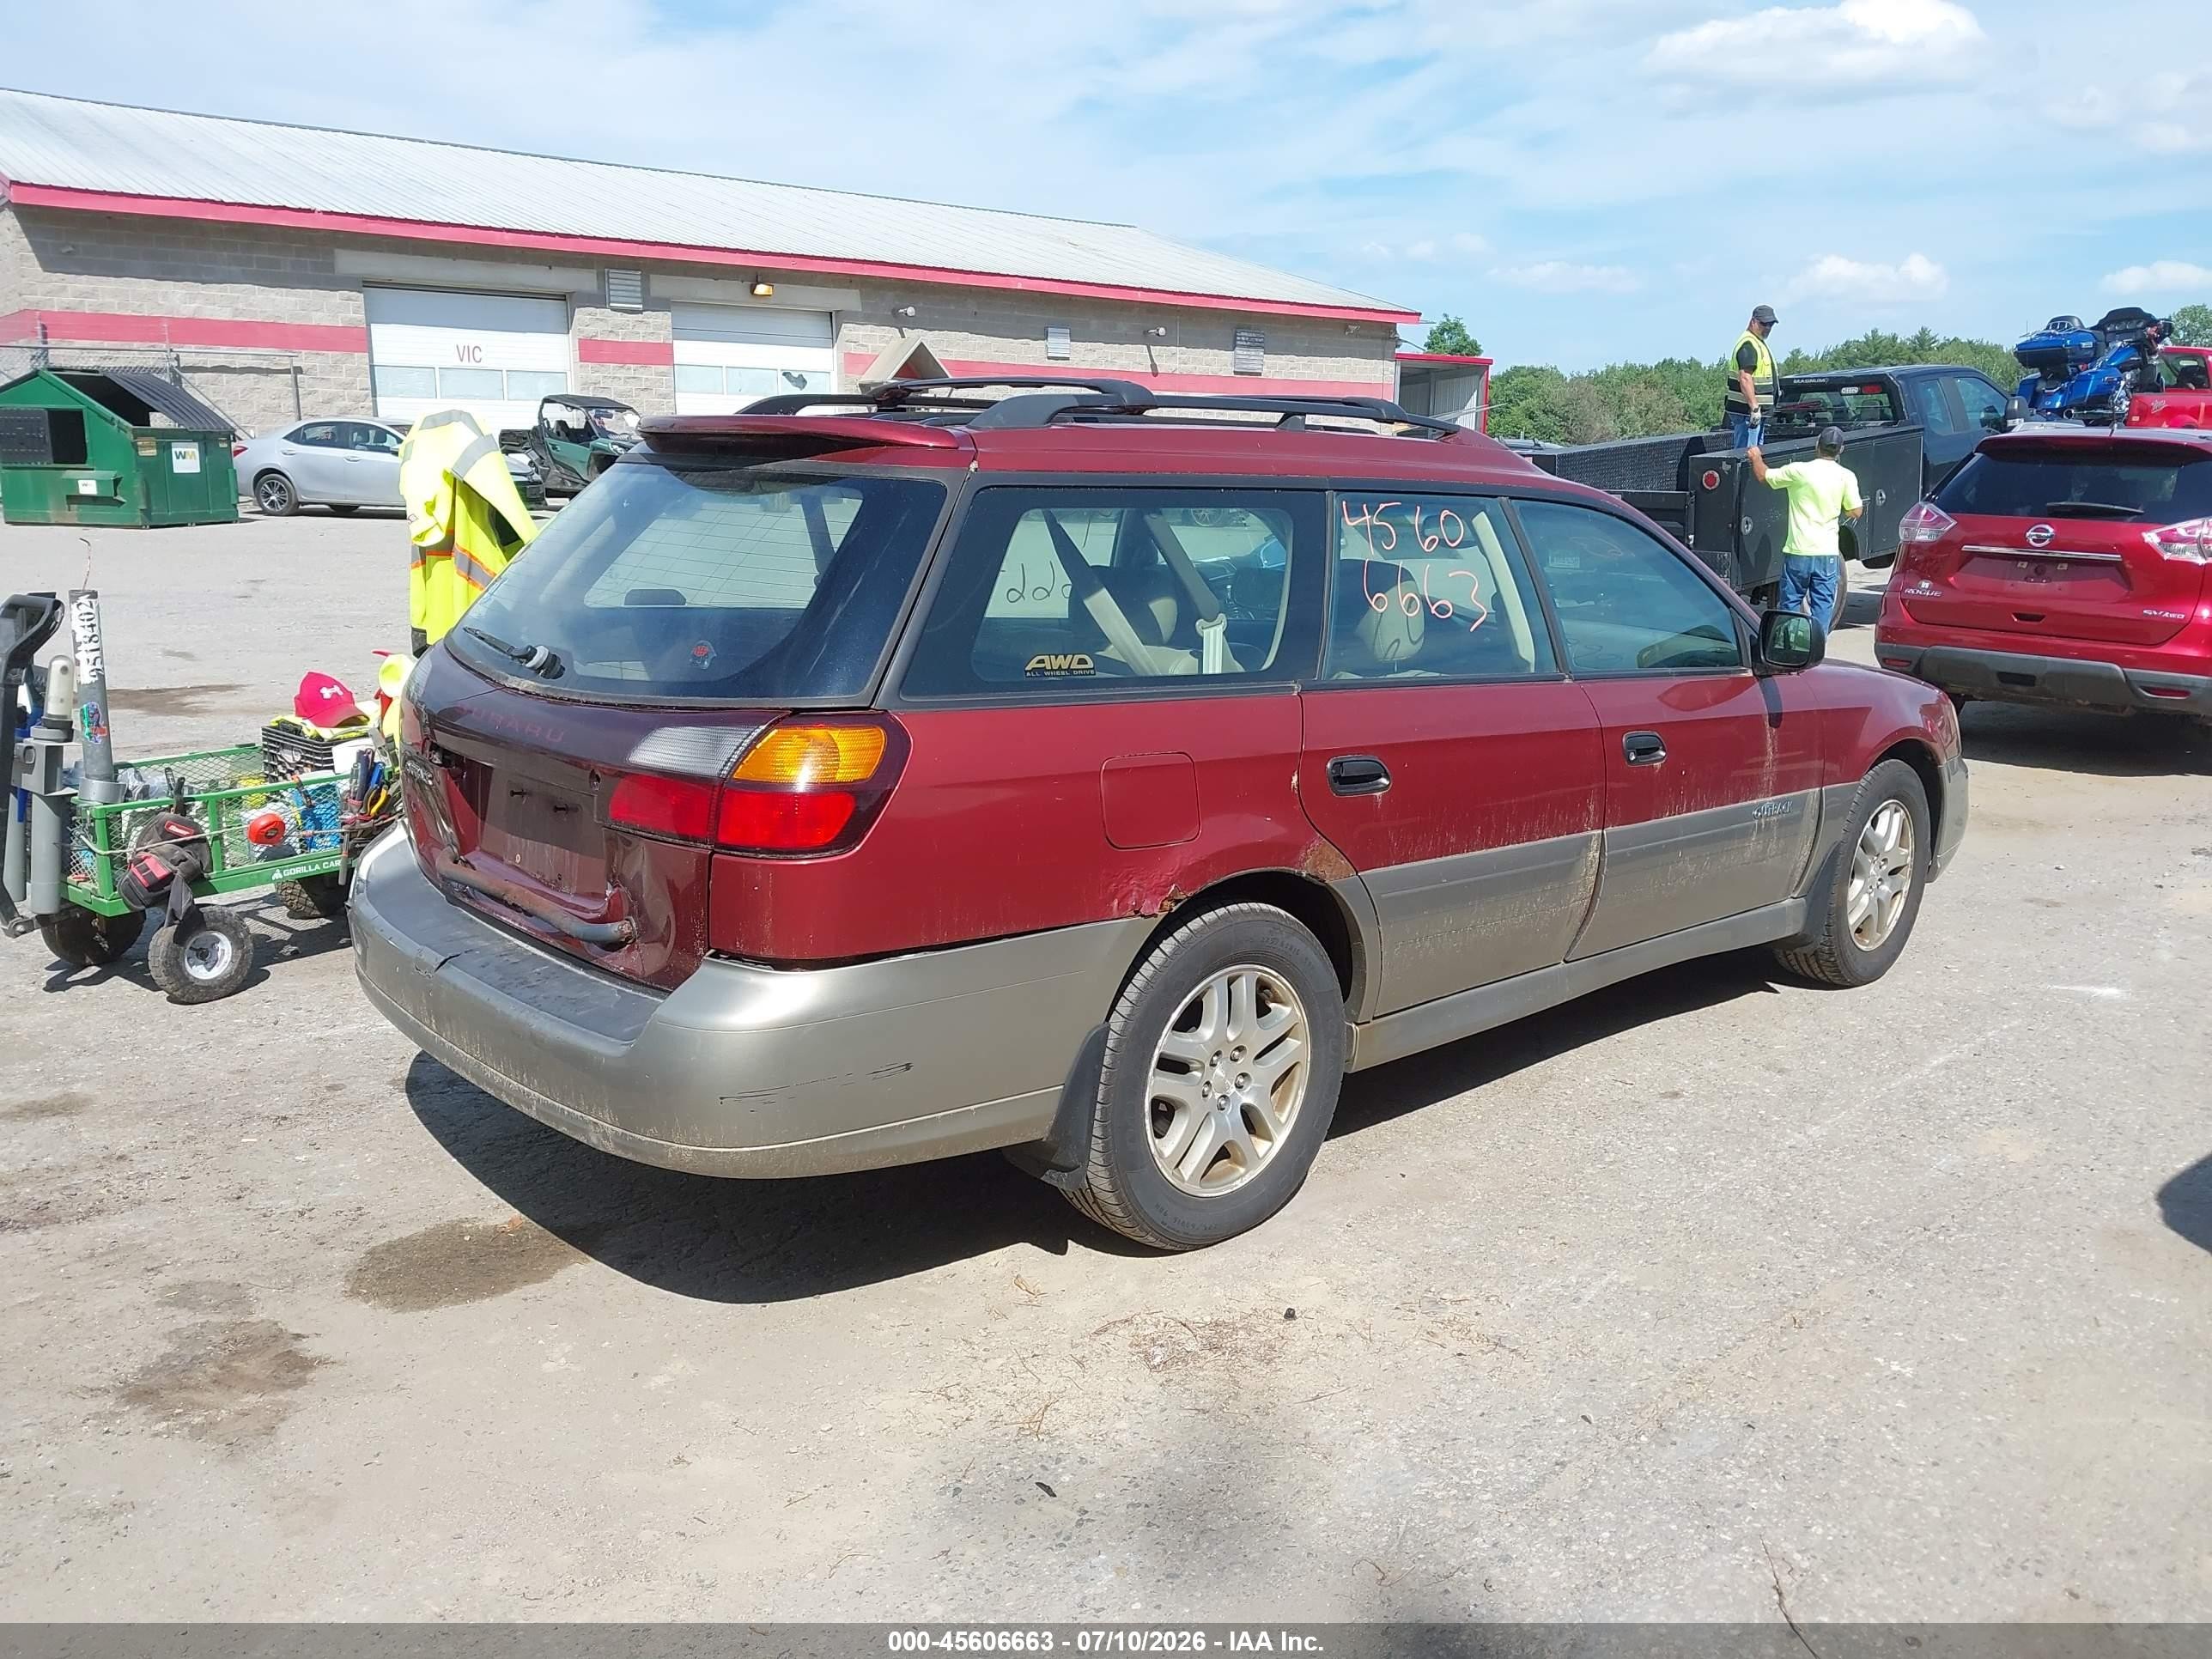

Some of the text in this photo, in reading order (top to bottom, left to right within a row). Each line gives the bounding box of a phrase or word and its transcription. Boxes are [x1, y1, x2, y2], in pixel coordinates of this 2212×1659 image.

[456, 344, 483, 363] VIC
[174, 451, 197, 460] WM
[1342, 501, 1464, 555] 4560
[1364, 558, 1487, 633] 6663
[1905, 588, 1942, 597] ROGUE
[1024, 654, 1094, 671] AWD
[283, 860, 342, 877] GORILLA CAR
